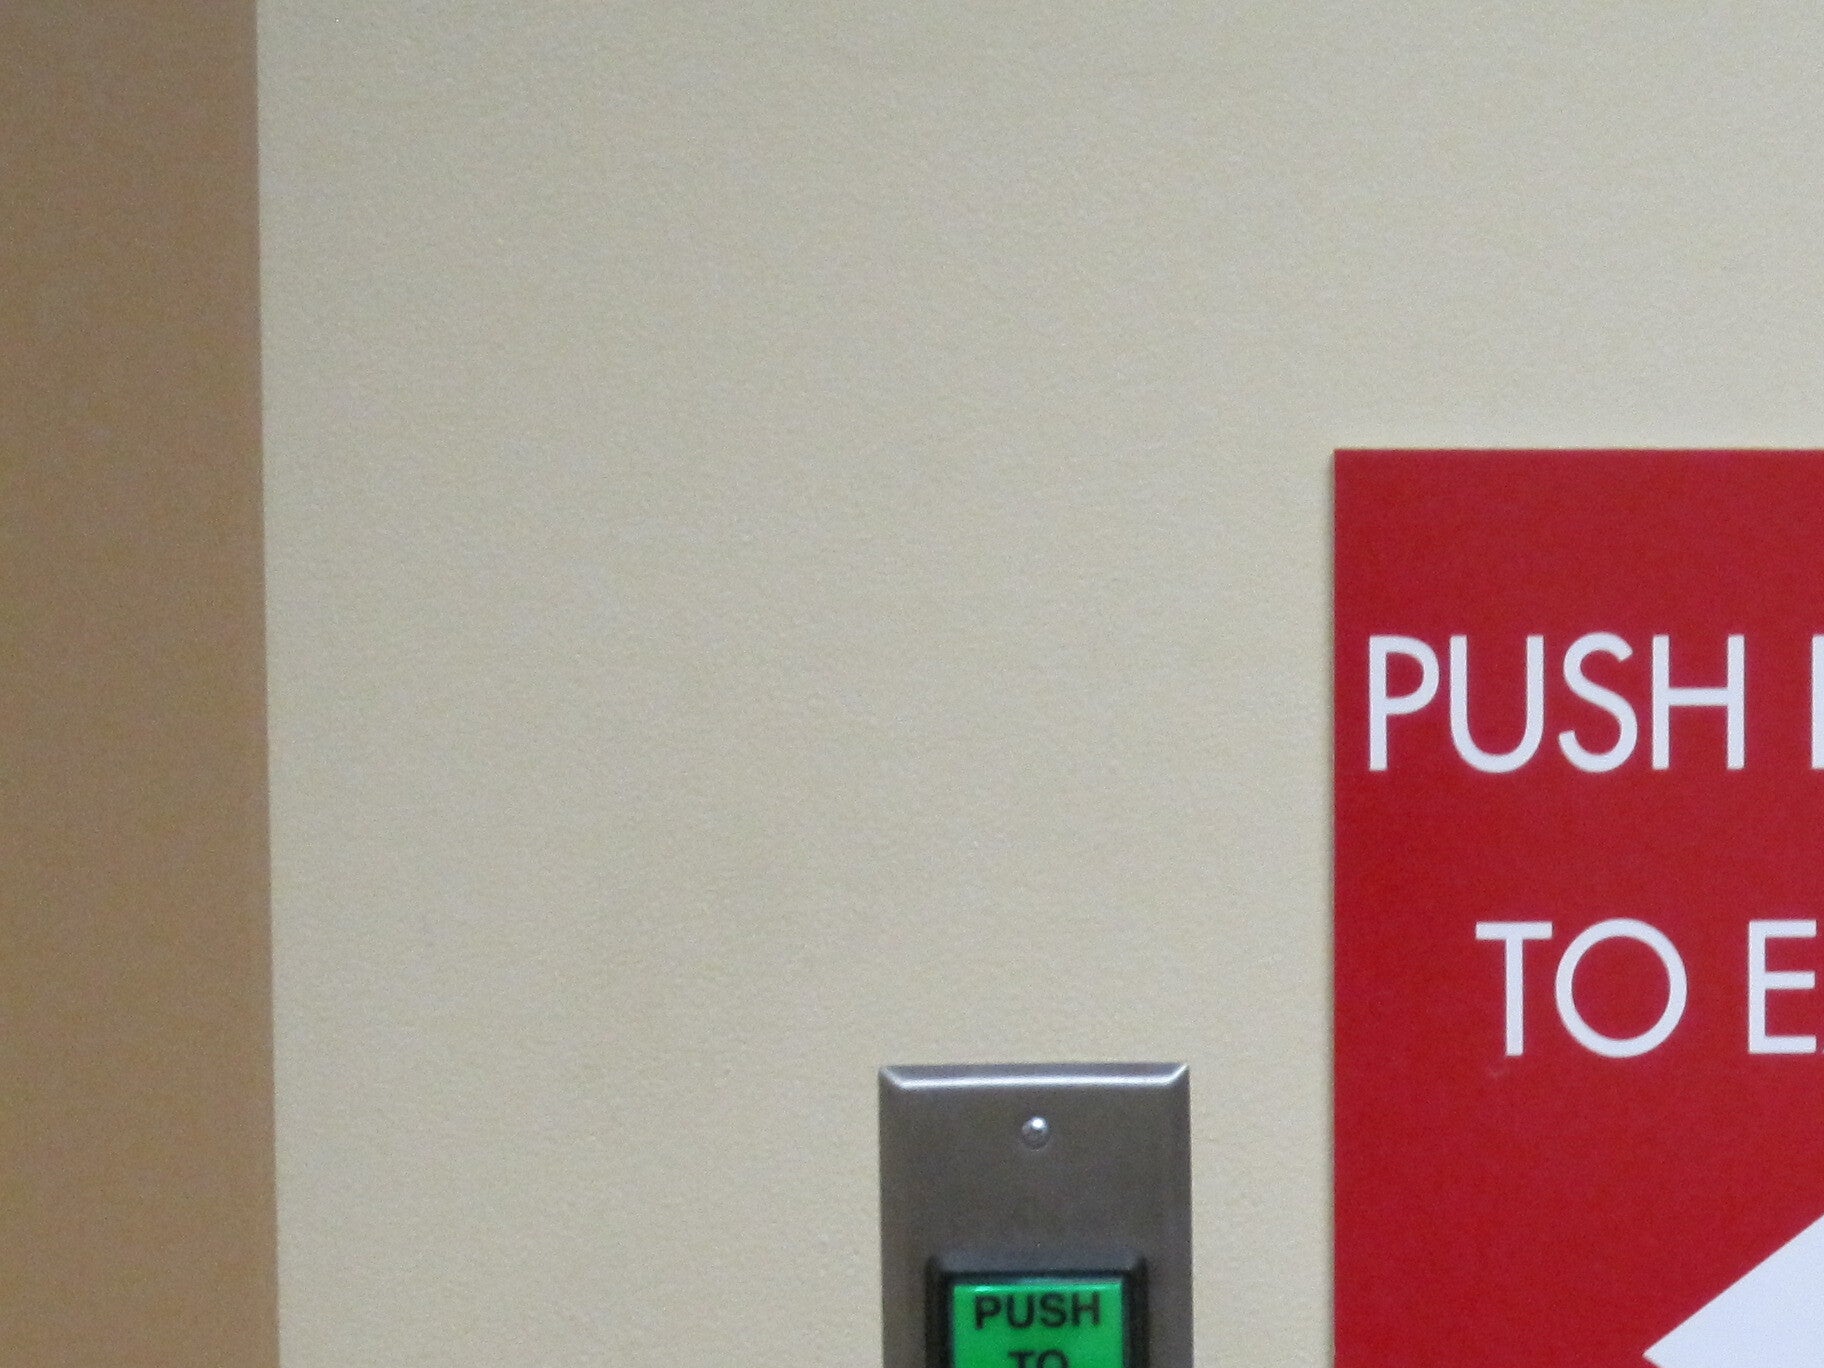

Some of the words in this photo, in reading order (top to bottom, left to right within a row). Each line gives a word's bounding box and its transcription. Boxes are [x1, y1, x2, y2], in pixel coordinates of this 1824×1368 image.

[1367, 630, 1747, 775] PUSH
[1474, 917, 1689, 1060] TO
[973, 1292, 1102, 1331] PUSH
